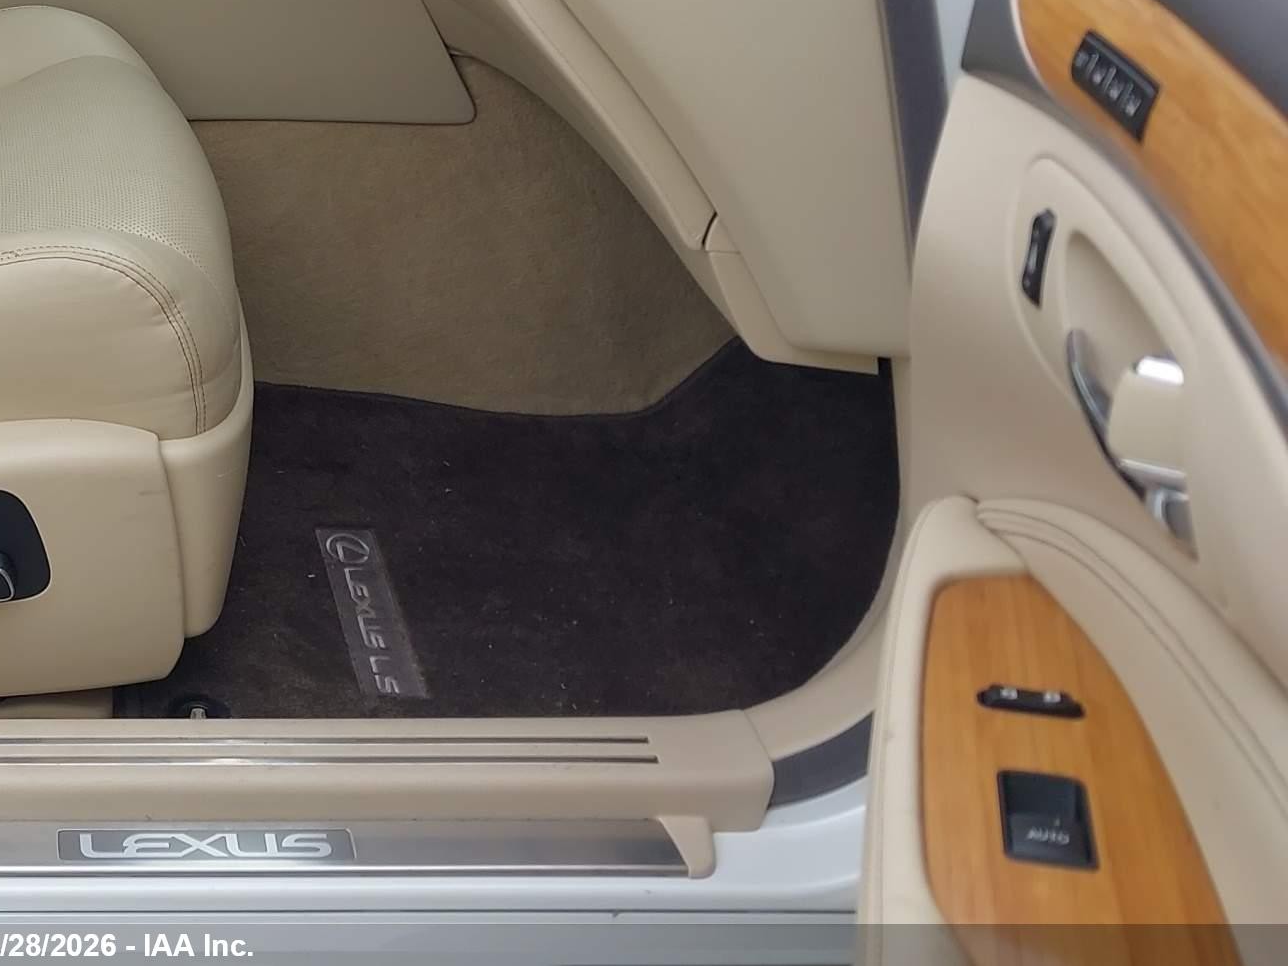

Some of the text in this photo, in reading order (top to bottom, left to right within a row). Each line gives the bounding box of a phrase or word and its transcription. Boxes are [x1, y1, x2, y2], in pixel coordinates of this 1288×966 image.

[344, 567, 401, 695] LEXUS LS
[79, 833, 332, 858] LEXUS
[1026, 826, 1070, 845] AUTO
